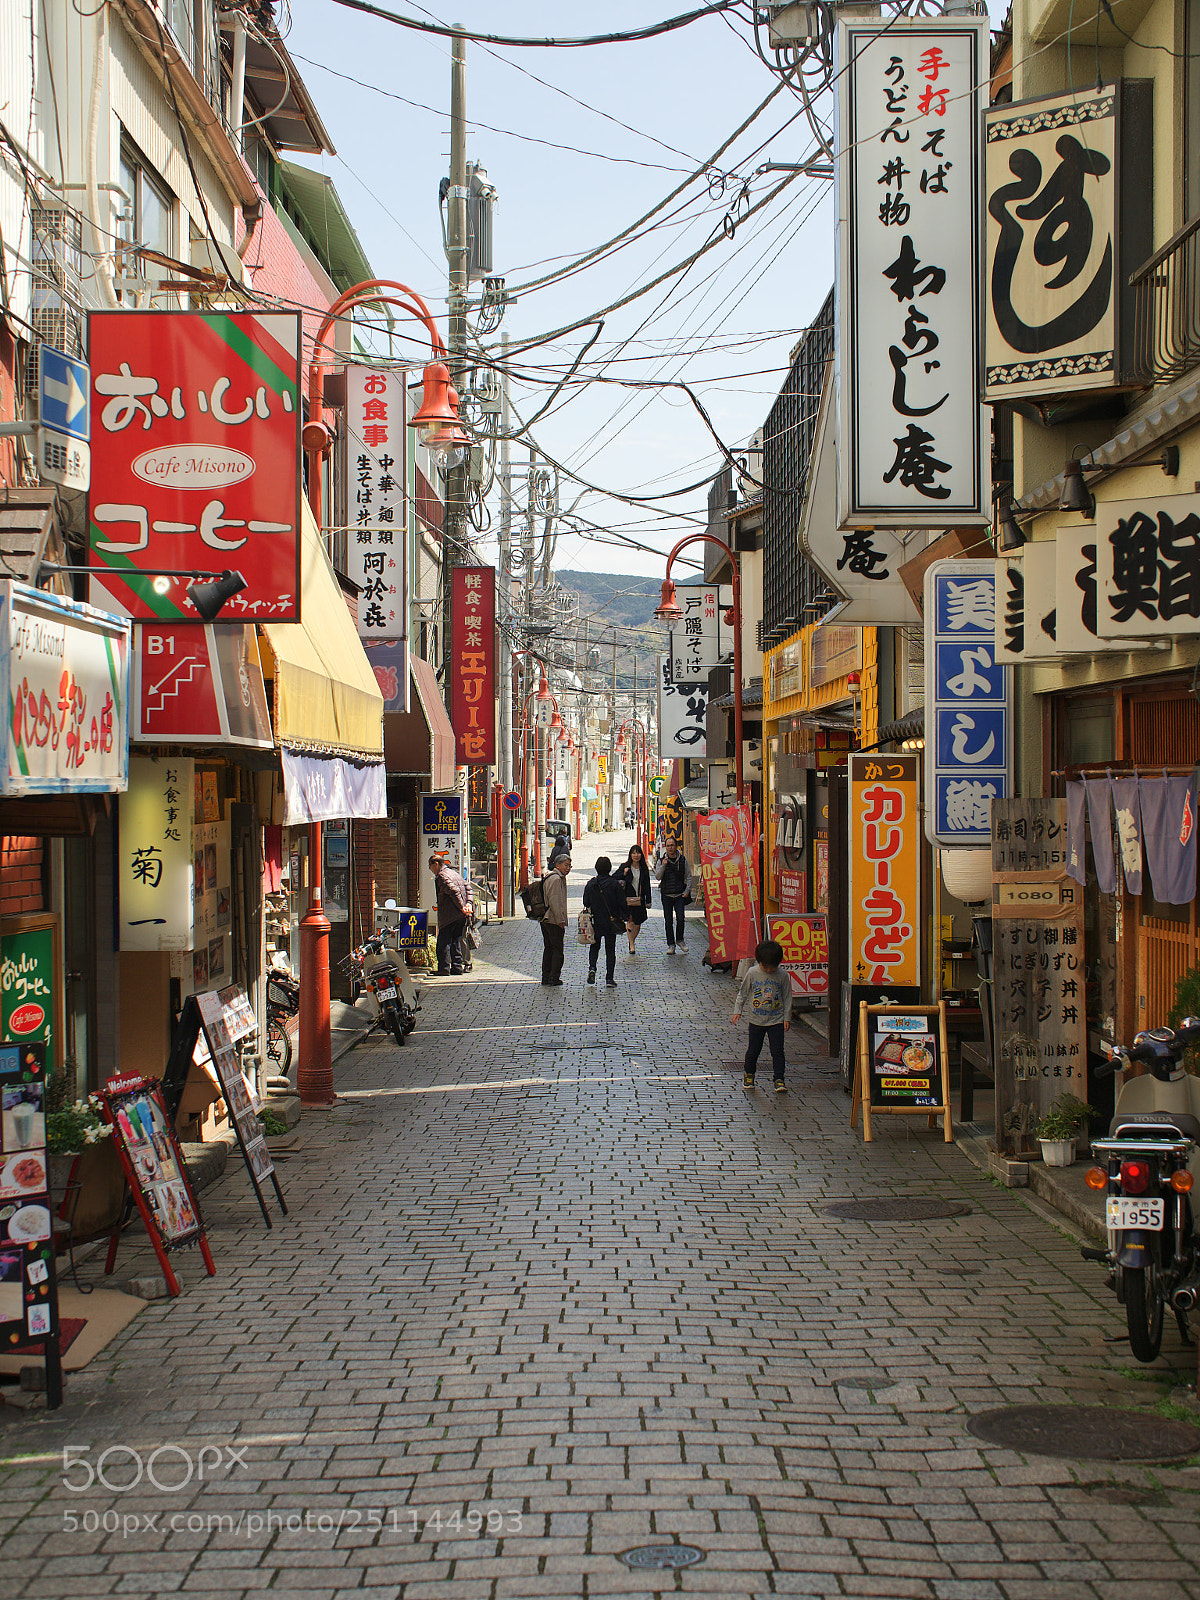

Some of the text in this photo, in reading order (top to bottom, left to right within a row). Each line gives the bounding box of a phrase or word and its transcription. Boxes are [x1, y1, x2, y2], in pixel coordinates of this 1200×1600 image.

[881, 234, 954, 500] わらじ庵
[94, 363, 294, 432] おいしい
[362, 374, 388, 448] お食事
[143, 456, 246, 478] Cafe Misono
[94, 500, 293, 553] コーヒー
[464, 573, 483, 647] 軽食・喫茶
[704, 592, 715, 618] 信州
[147, 635, 175, 655] B1
[684, 596, 703, 674] 戸隠そば
[460, 651, 487, 759] エリーゼ
[864, 762, 905, 780] かつ
[162, 768, 181, 842] お食事処
[424, 823, 458, 831] COFFEE
[442, 815, 459, 824] KEY
[427, 837, 456, 849] 喫茶
[772, 920, 827, 947] 20円
[1009, 951, 1078, 971] にぎりずし
[1009, 978, 1078, 998] 穴子丼
[1010, 1004, 1078, 1024] アジ丼
[107, 1075, 143, 1093] Welcome
[1133, 1115, 1174, 1124] HONDA
[1122, 1208, 1161, 1227] 1955
